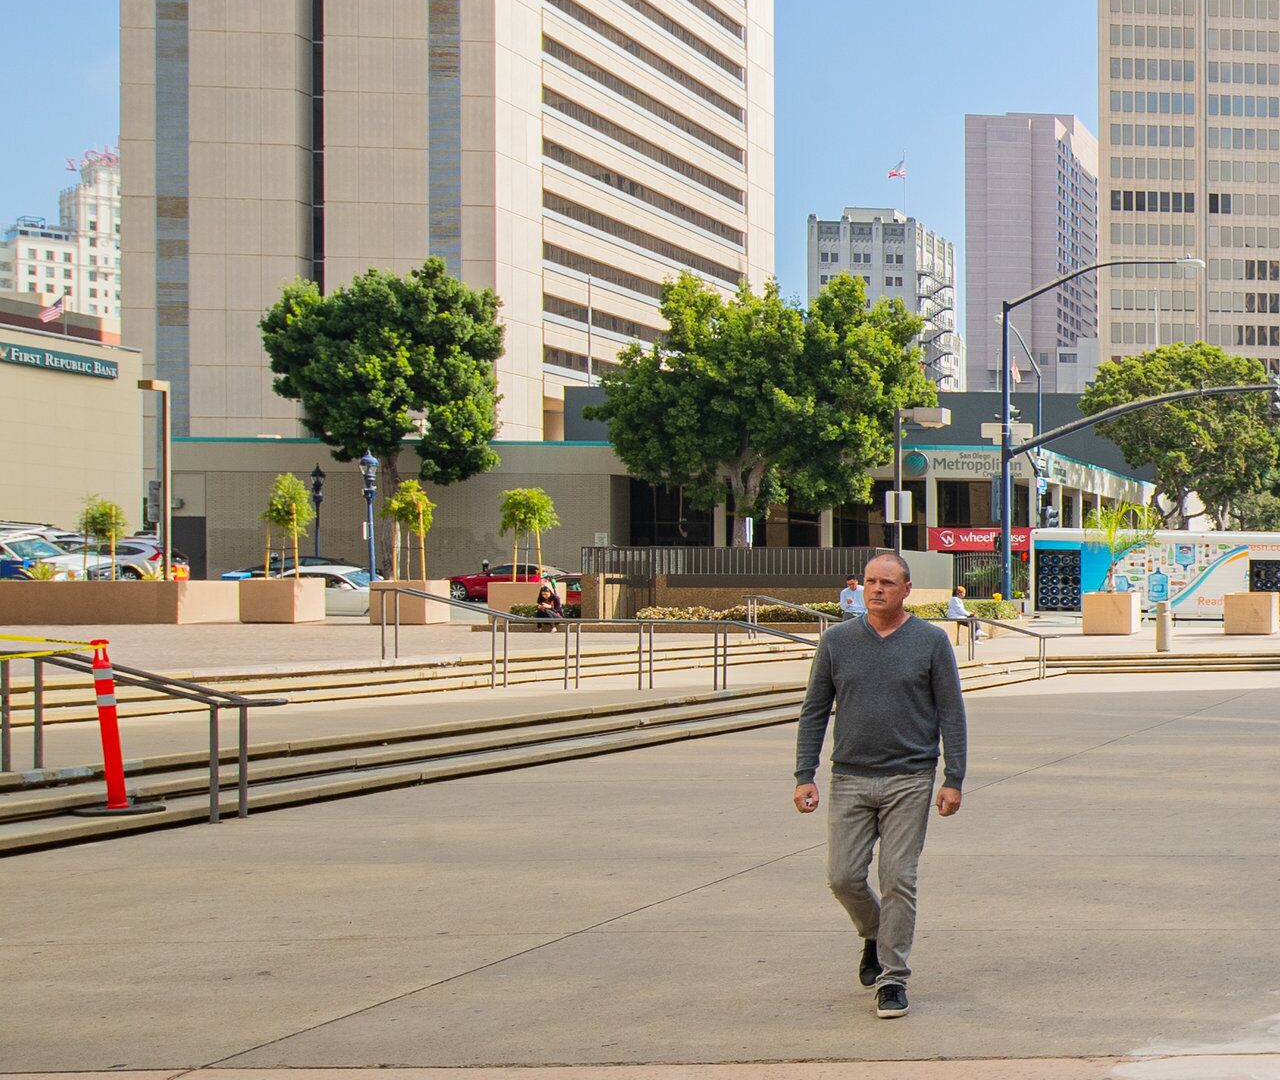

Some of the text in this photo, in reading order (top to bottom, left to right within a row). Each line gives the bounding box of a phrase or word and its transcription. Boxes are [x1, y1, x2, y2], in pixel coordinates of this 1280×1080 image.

[10, 347, 117, 377] FIRST REPUBLIC BANK
[960, 452, 992, 462] San Diego
